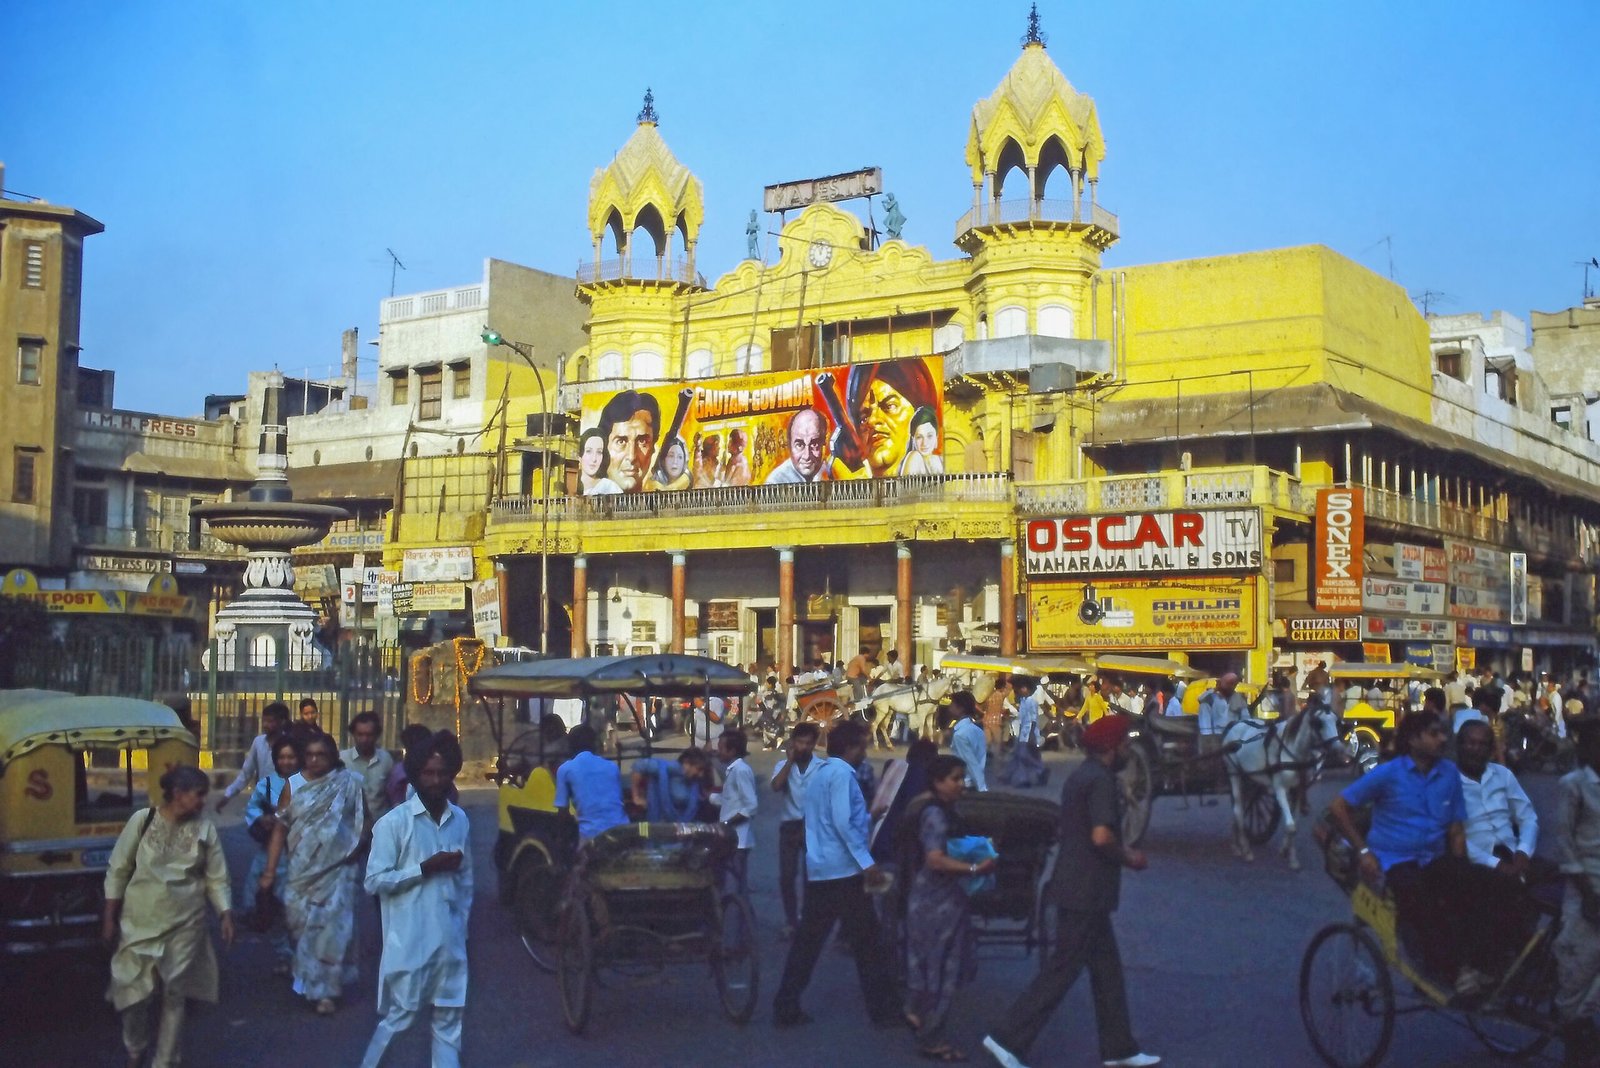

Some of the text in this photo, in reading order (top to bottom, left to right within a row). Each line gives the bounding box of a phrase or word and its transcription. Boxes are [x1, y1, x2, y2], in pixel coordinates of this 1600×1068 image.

[771, 172, 876, 207] MAJESTIC
[723, 380, 751, 390] SUBHASH
[695, 374, 814, 419] GAUTAM-GOVINDA
[140, 420, 197, 437] PRESS
[1027, 512, 1254, 554] OSCAR TV
[1325, 493, 1353, 578] SONEX
[111, 559, 142, 571] PRESS
[1028, 550, 1262, 573] MAHARAJA LAL & SONS
[52, 592, 97, 605] POST
[1152, 599, 1241, 611] AHUJA
[1291, 618, 1340, 630] CITIZEN
[1291, 629, 1340, 641] CITIZEN
